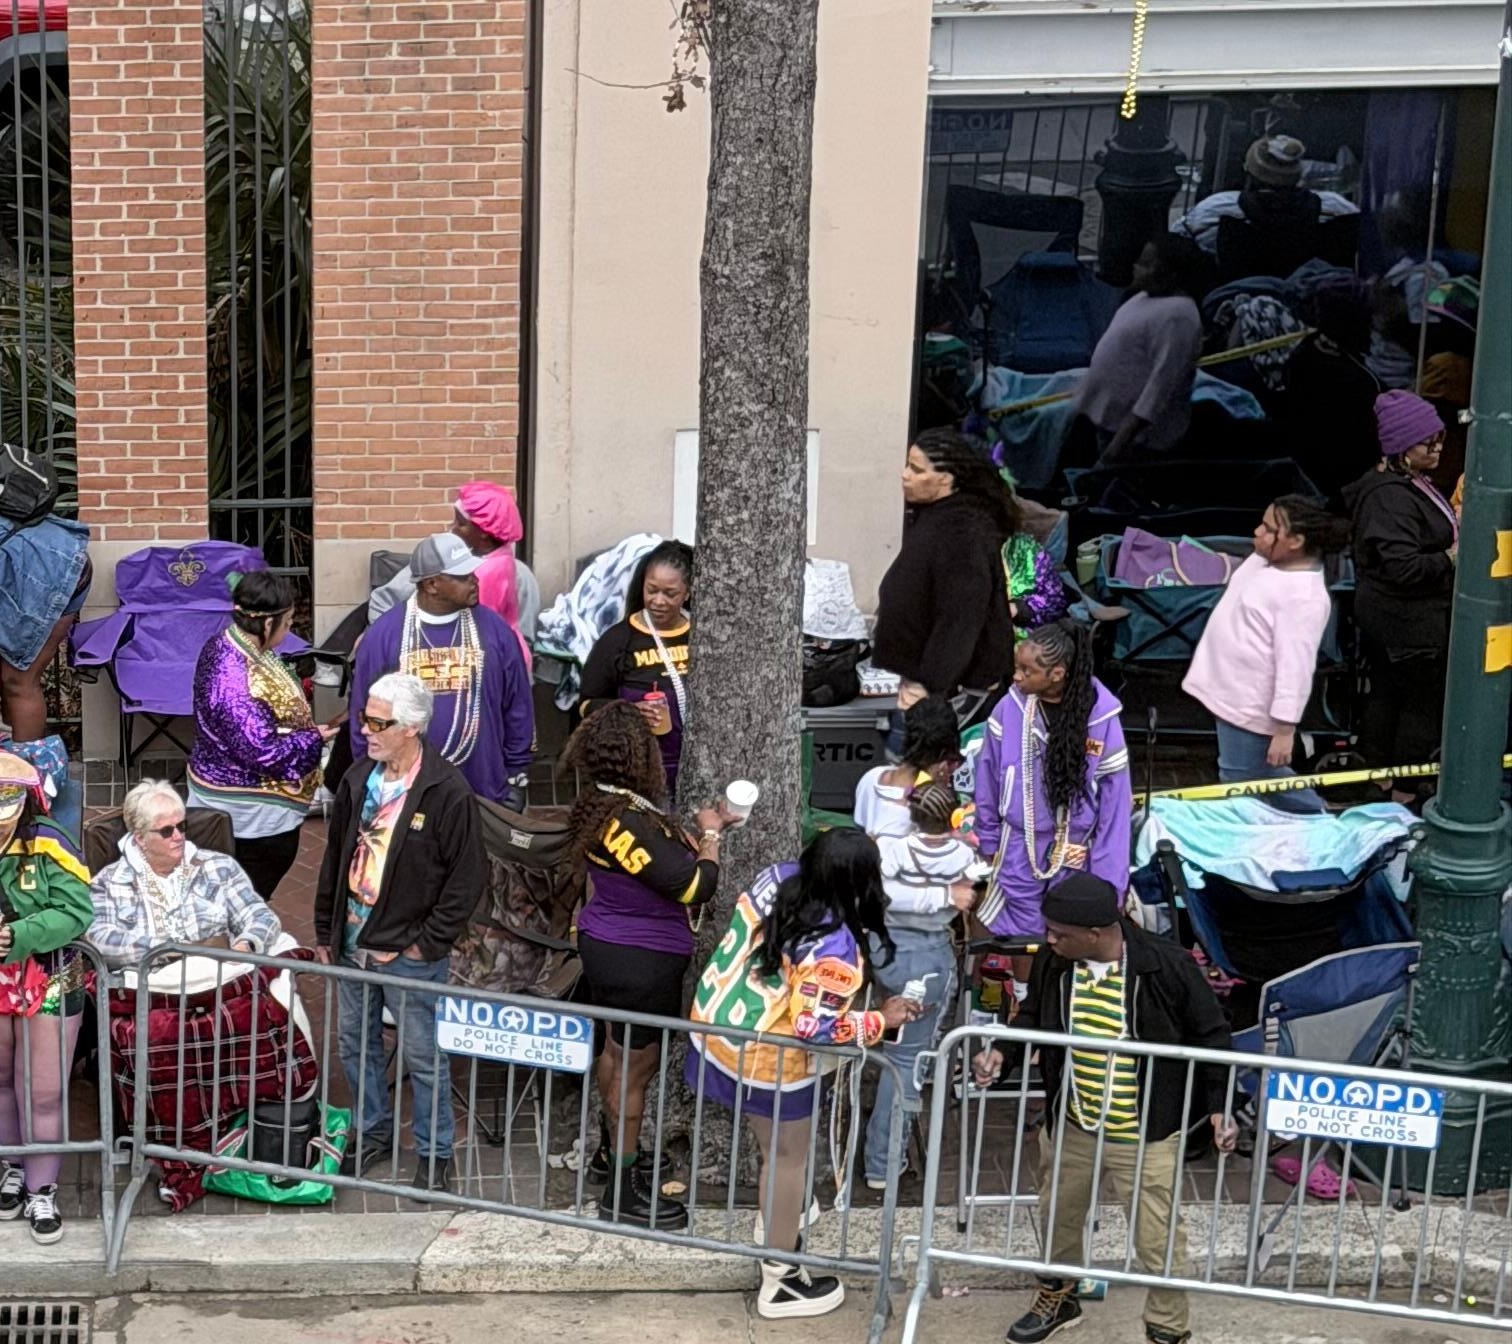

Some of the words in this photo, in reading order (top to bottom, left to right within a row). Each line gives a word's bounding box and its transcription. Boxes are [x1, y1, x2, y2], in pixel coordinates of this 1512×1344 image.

[1226, 777, 1325, 798] CAUTION
[20, 864, 37, 890] C
[444, 996, 496, 1027] N.O.
[532, 1011, 585, 1041] P.D.
[453, 1037, 474, 1049] DO
[484, 1043, 518, 1056] NOT
[524, 1049, 573, 1065] CROSS
[463, 1028, 518, 1045] POLICE
[531, 1038, 564, 1052] LINE
[1277, 1072, 1341, 1105] N.O.
[1375, 1083, 1436, 1116] P.D.
[1284, 1116, 1308, 1129] DO
[1317, 1121, 1351, 1135] NOT
[1360, 1125, 1418, 1142] CROSS
[1297, 1105, 1359, 1123] POLICE
[1368, 1112, 1407, 1128] LINE
